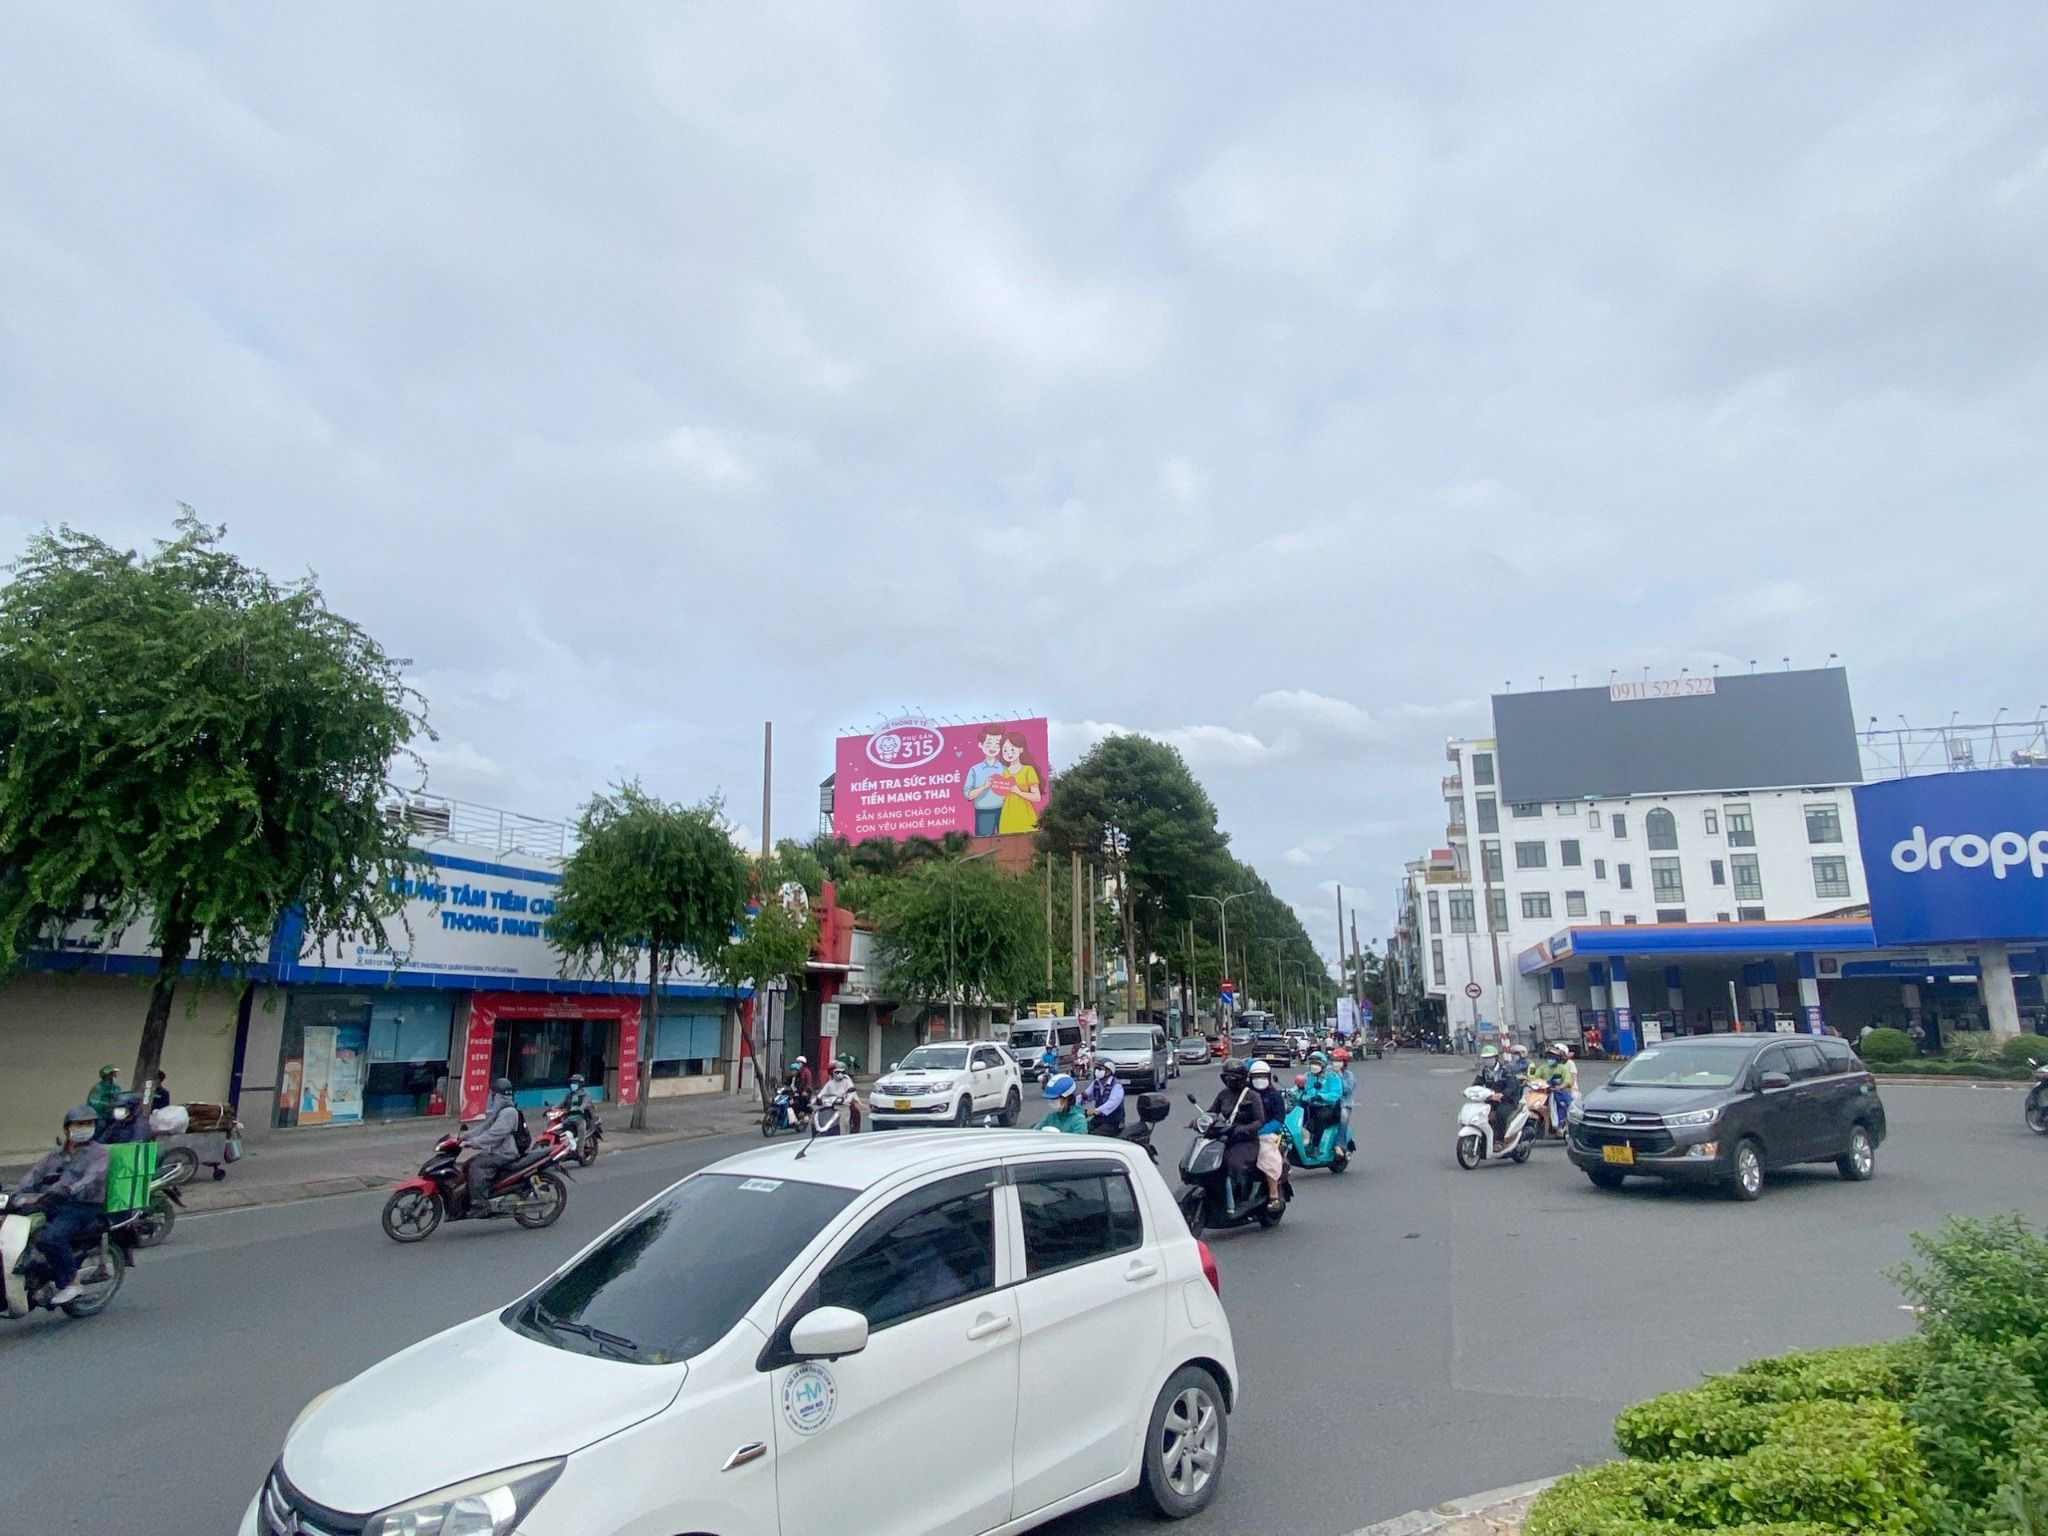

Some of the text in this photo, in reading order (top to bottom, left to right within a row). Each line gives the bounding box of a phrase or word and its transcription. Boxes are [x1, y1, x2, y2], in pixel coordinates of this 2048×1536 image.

[1611, 677, 1713, 700] 0911 522 522
[902, 740, 934, 758] 315
[879, 779, 902, 790] TRA
[903, 775, 927, 787] SỨC
[887, 791, 922, 803] MANG
[924, 788, 950, 800] THAI
[876, 809, 903, 820] SÀNG
[933, 804, 956, 815] ĐÓN
[855, 824, 876, 833] CON
[878, 820, 897, 832] YÊU
[450, 883, 488, 908] TÂM
[796, 1381, 822, 1402] HM
